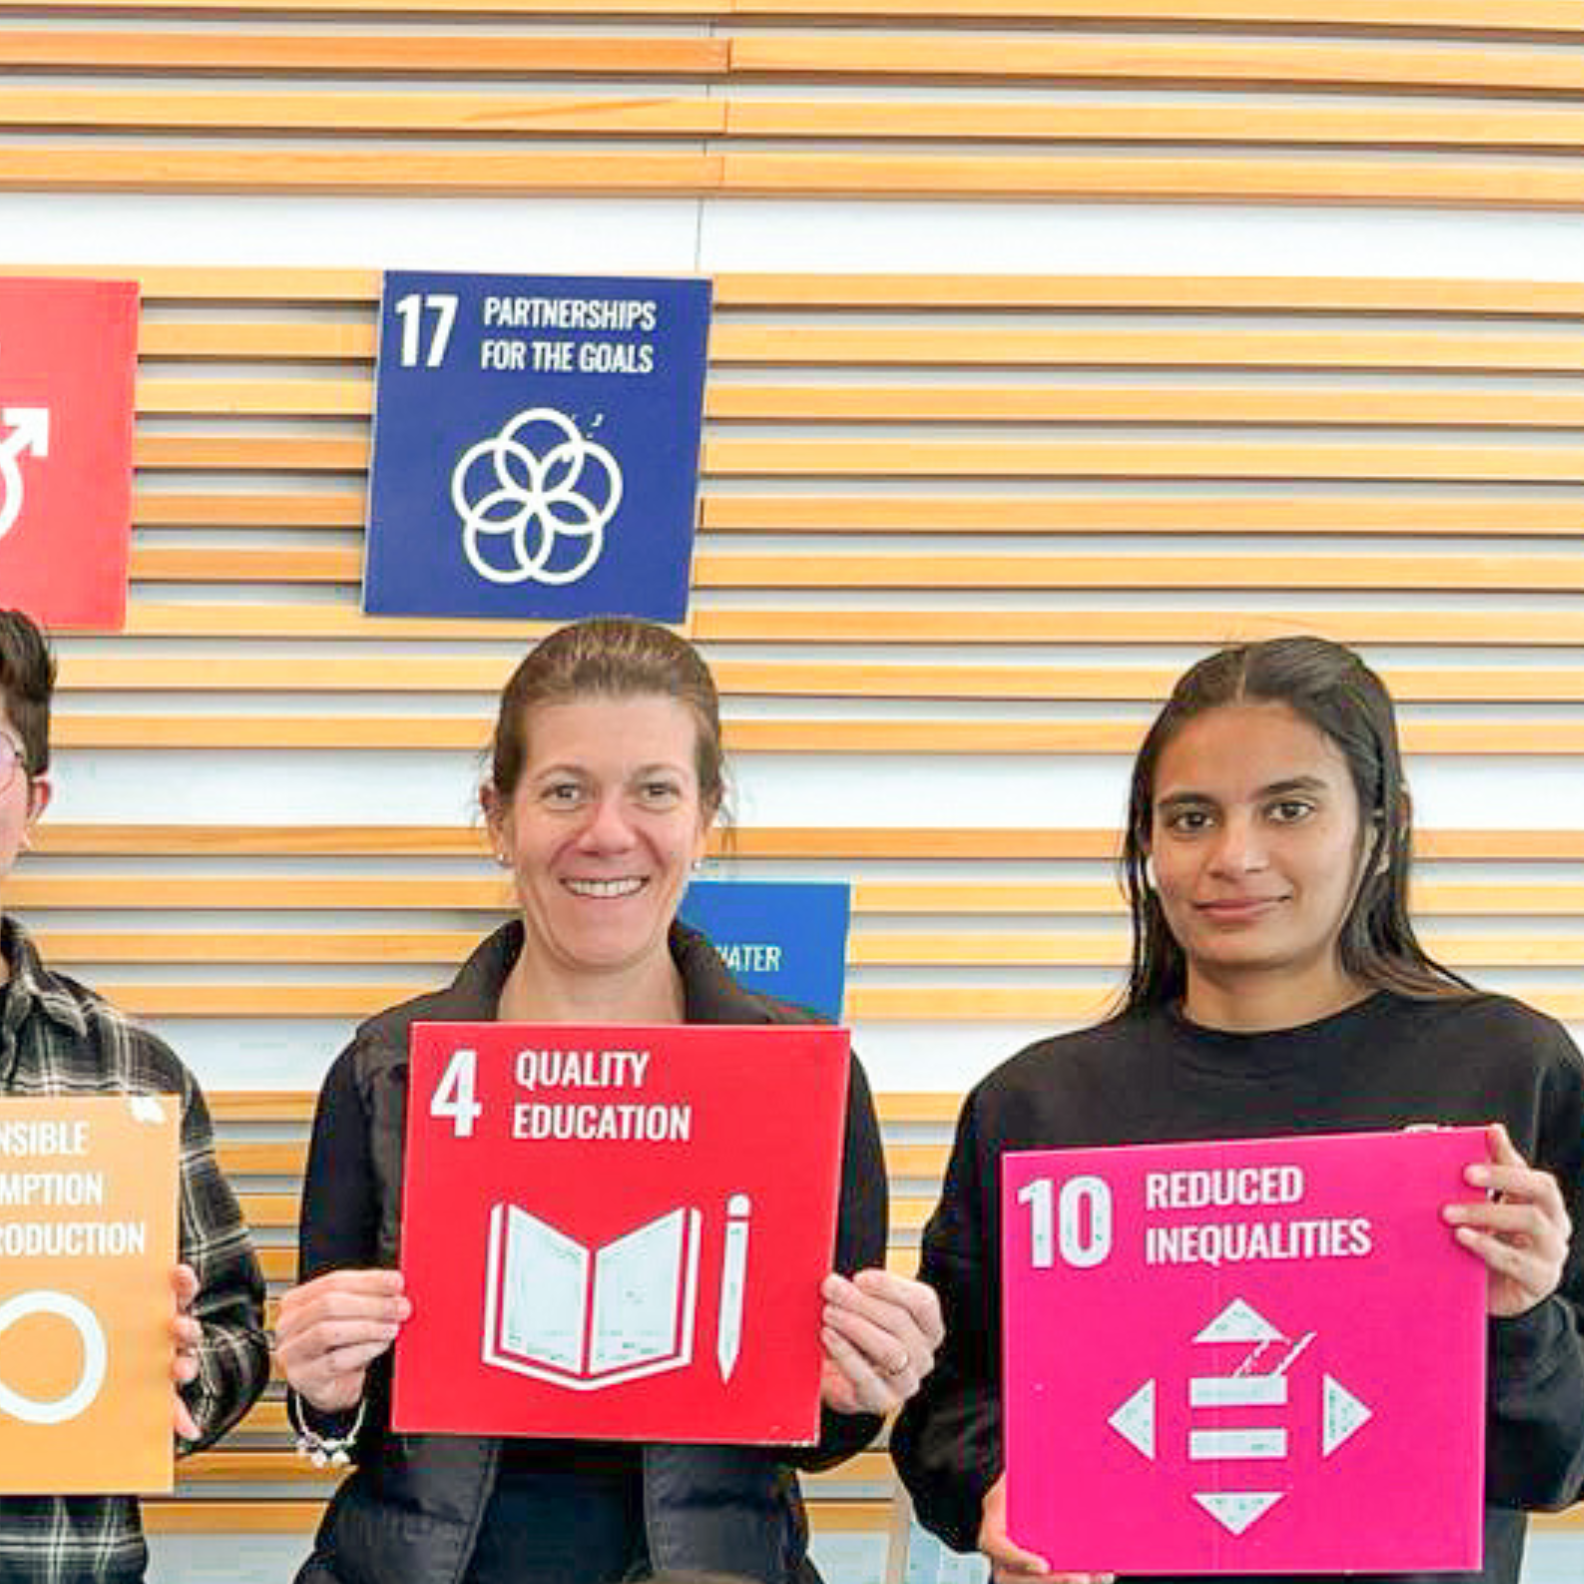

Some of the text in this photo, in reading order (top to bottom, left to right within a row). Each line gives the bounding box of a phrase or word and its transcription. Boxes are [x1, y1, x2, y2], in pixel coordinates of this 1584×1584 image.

[396, 295, 458, 366] 17
[484, 297, 656, 330] PARTNERSHIPS
[481, 340, 653, 373] FOR THE GOALS
[516, 1050, 649, 1090] QUALITY
[431, 1050, 481, 1136] 4
[513, 1103, 691, 1140] EDUCATION
[1146, 1166, 1303, 1209] REDUCED
[1019, 1176, 1111, 1267] 10
[1146, 1218, 1371, 1266] INEQUALITIES
